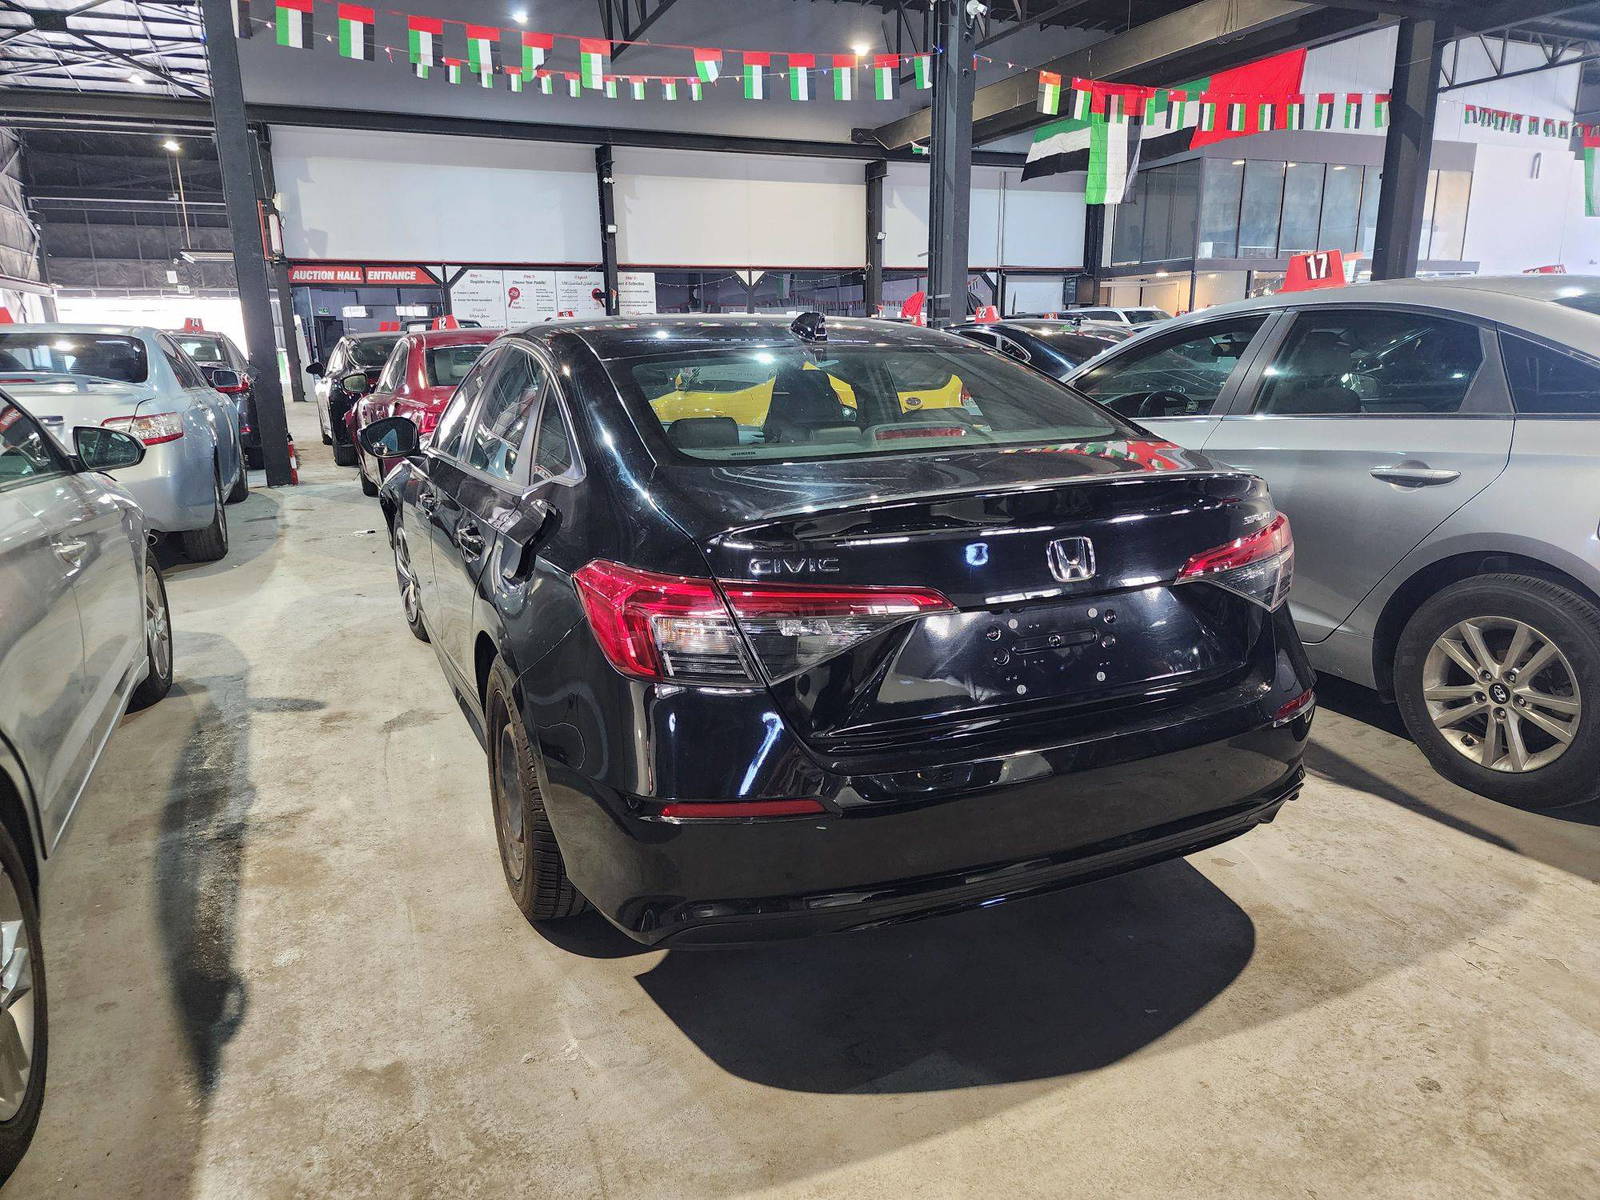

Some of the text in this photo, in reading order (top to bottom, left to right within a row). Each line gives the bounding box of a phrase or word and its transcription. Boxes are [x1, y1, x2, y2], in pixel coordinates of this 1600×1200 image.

[1306, 253, 1328, 280] 17
[292, 270, 417, 281] AUCTION HALL ENTRANCE
[978, 306, 987, 319] 22
[438, 316, 447, 330] 12
[748, 557, 841, 575] CIVIC
